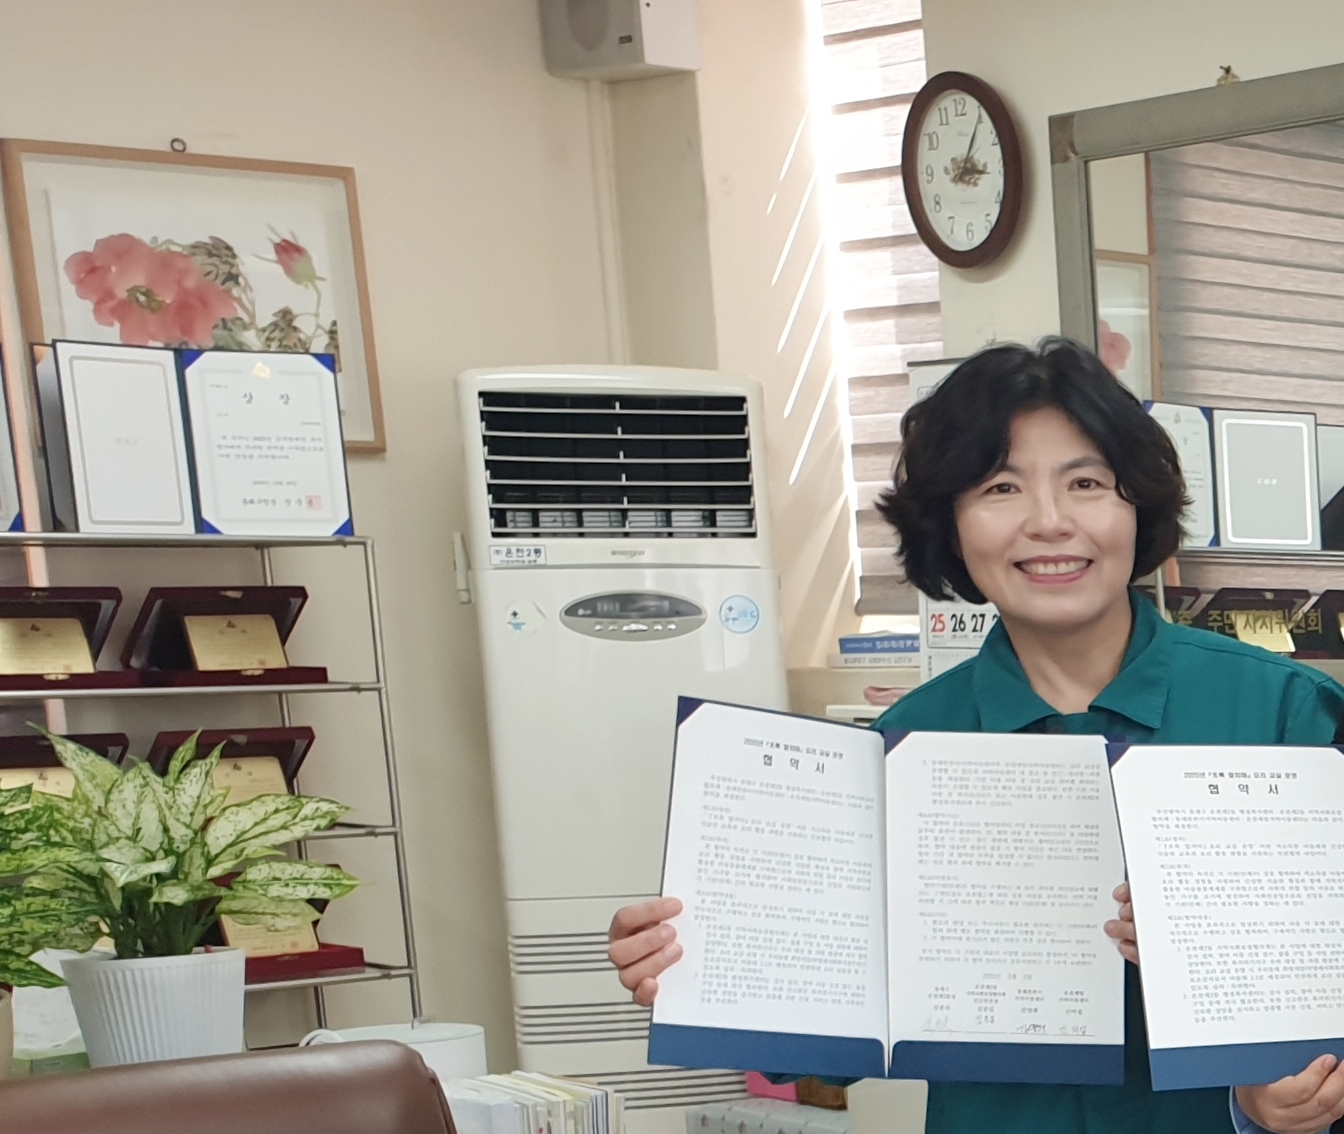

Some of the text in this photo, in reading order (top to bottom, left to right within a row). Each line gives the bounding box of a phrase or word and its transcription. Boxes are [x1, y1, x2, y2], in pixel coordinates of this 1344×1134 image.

[937, 106, 950, 127] 11
[953, 97, 967, 118] 12
[924, 131, 940, 151] 10
[925, 164, 935, 185] 9
[933, 193, 943, 214] 8
[948, 216, 955, 236] 7
[965, 221, 975, 242] 6
[930, 613, 986, 633] 25 26 27
